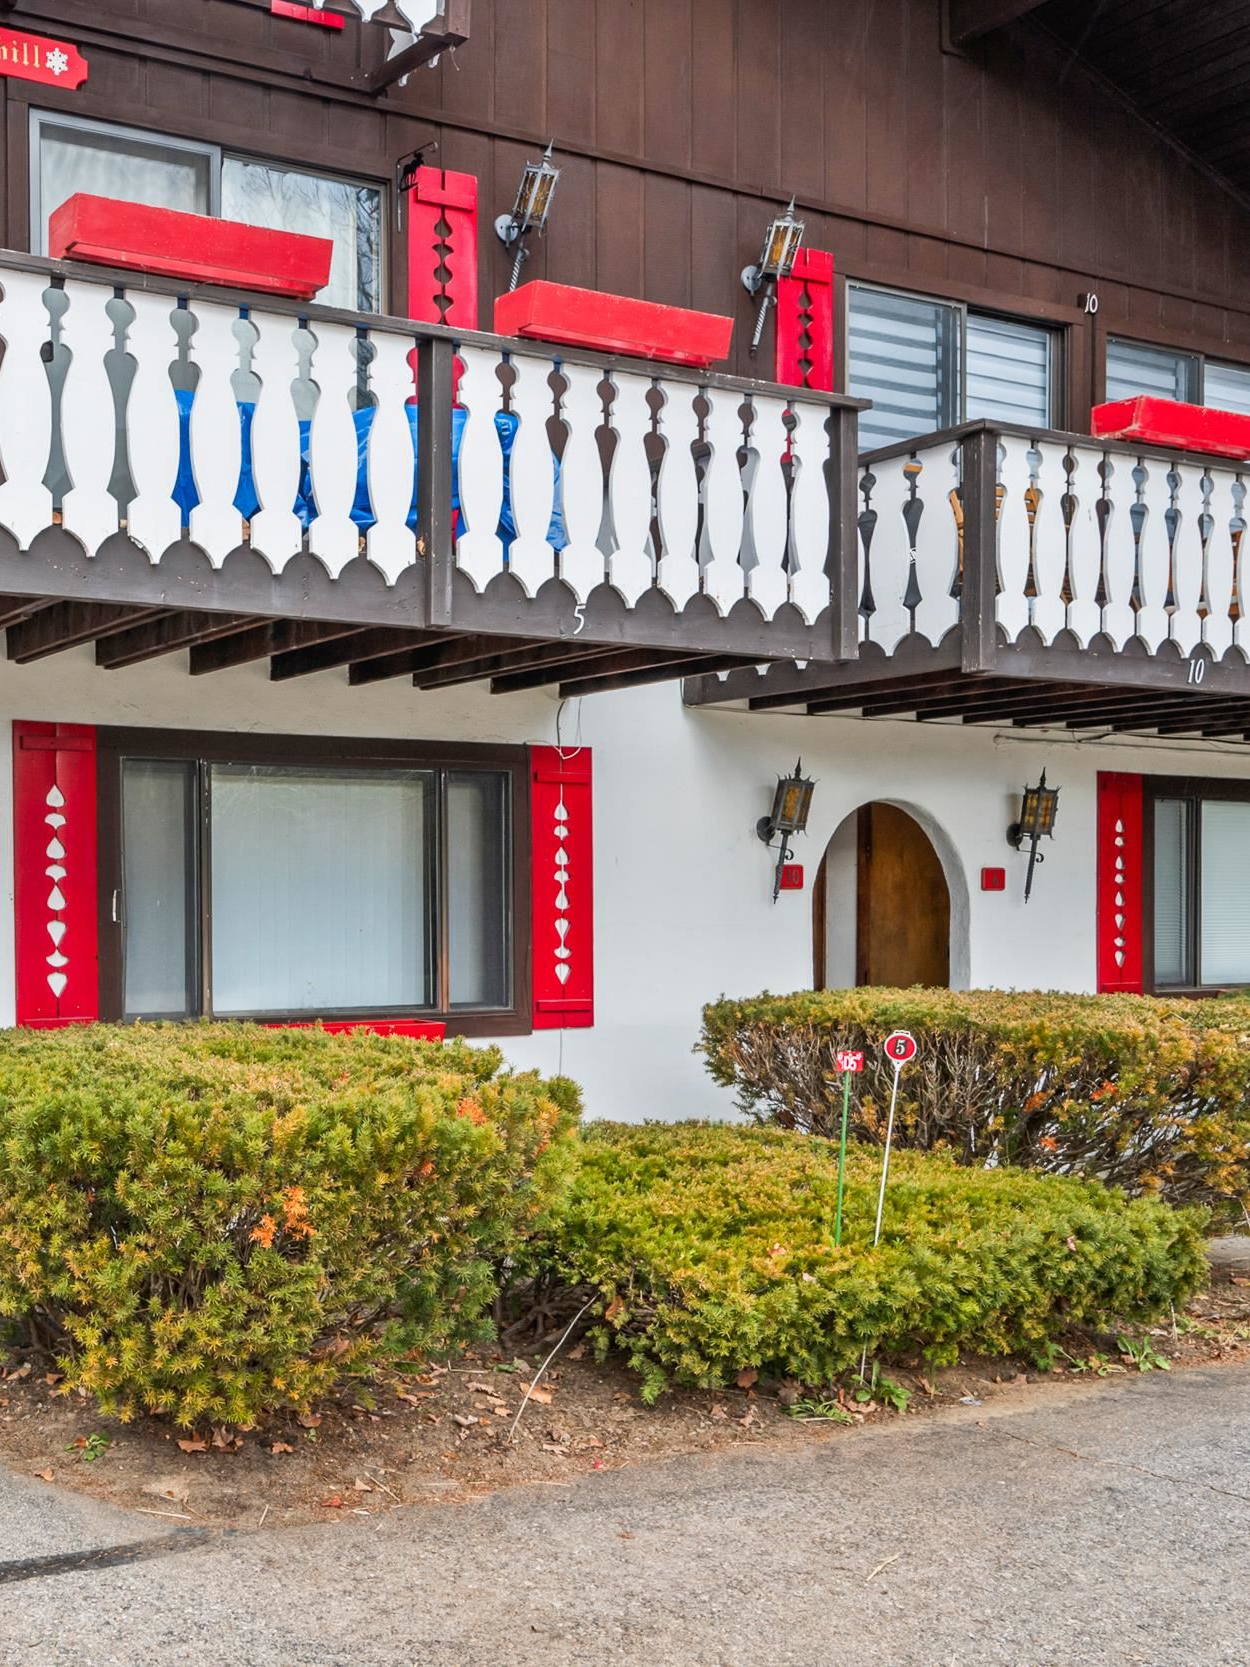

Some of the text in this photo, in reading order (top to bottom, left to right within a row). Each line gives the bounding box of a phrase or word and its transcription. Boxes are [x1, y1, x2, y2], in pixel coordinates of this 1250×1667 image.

[1085, 293, 1098, 313] 10
[574, 605, 586, 635] 5
[1188, 659, 1204, 684] 10
[895, 1039, 907, 1055] 5
[844, 1055, 857, 1071] D5
